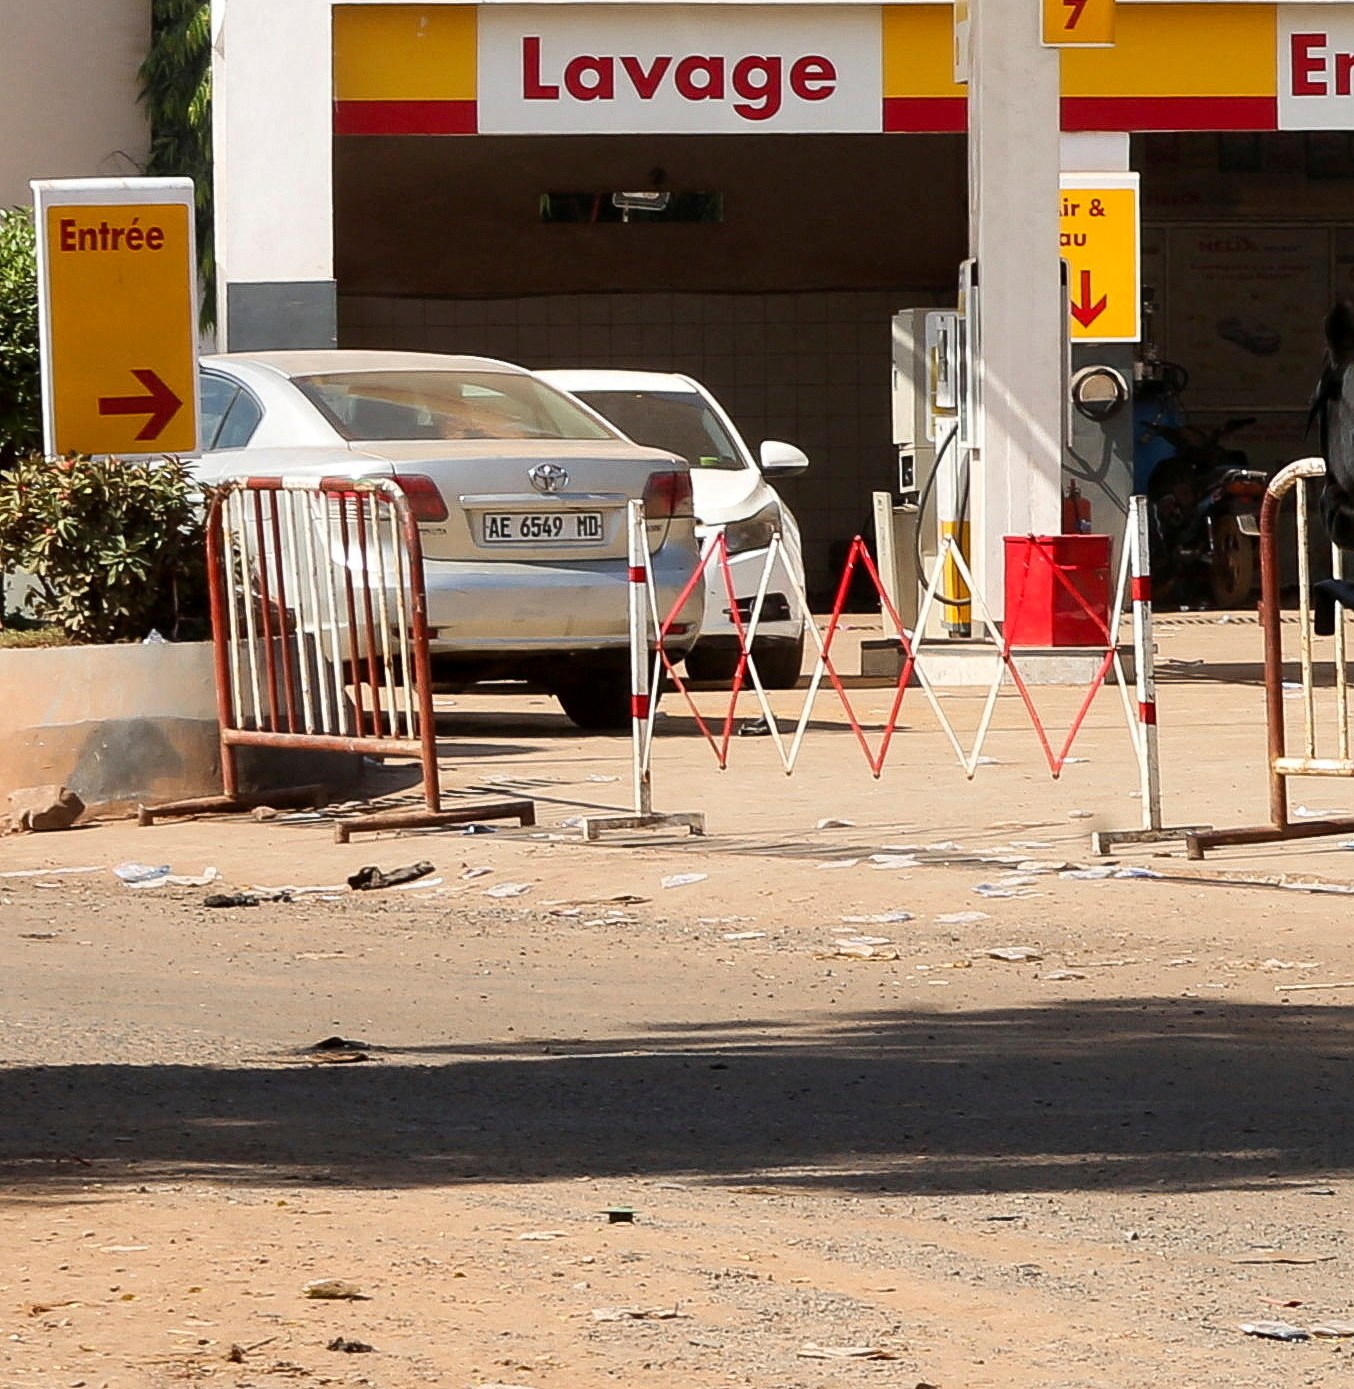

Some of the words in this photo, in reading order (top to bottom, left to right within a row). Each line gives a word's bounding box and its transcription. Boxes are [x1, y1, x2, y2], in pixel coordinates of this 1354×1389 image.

[523, 36, 837, 121] Lavage
[1060, 197, 1081, 217] ir
[1088, 198, 1106, 217] &
[60, 217, 165, 251] Entrée
[1060, 232, 1087, 247] au
[489, 516, 512, 538] AE
[520, 516, 563, 537] 6549
[577, 515, 599, 537] MD
